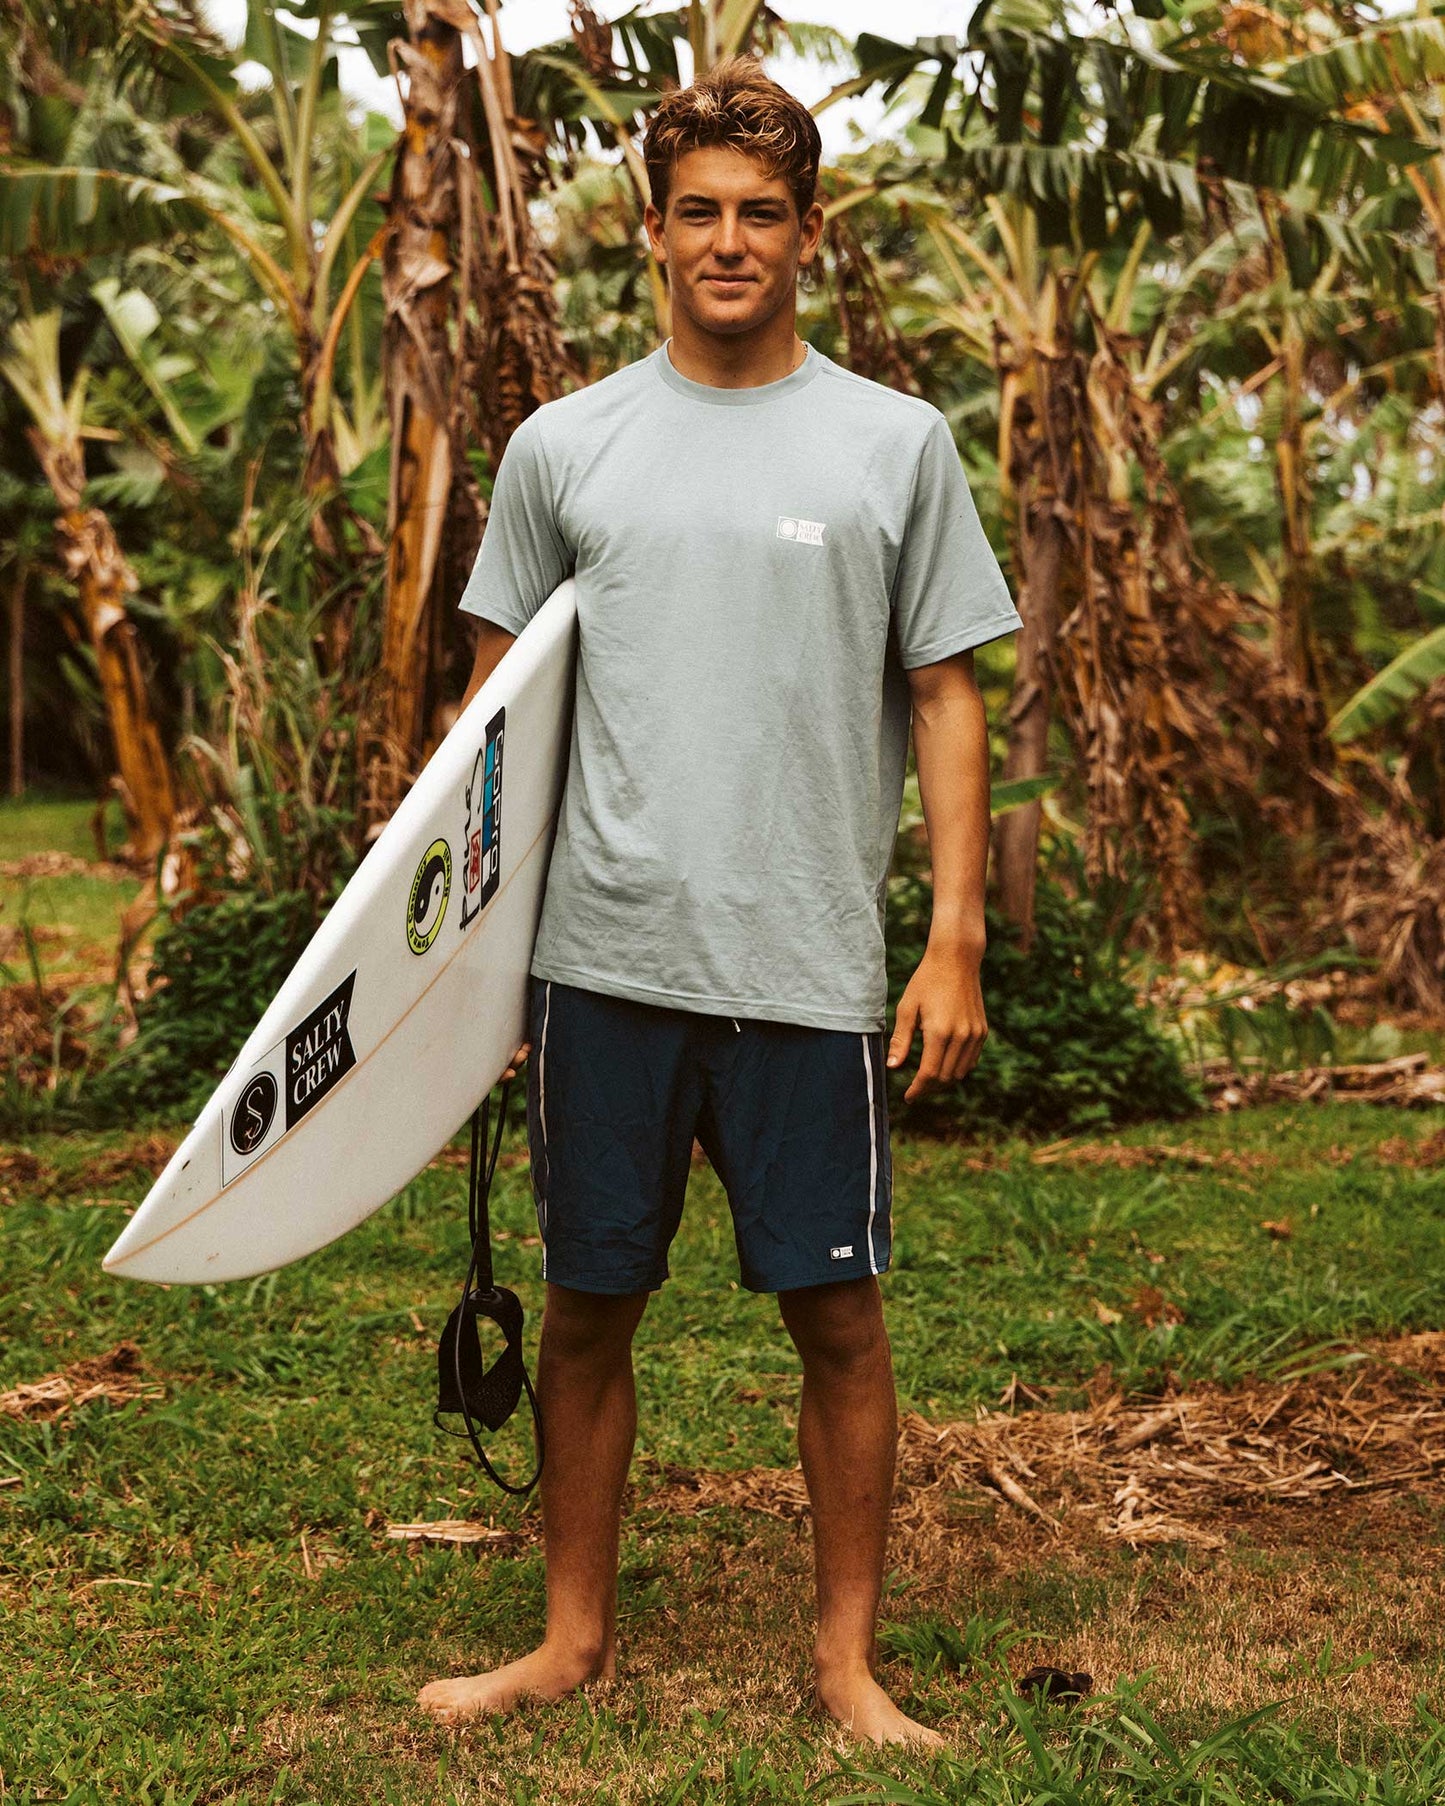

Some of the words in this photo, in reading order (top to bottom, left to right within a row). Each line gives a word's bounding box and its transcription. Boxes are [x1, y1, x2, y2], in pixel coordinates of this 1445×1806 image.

[490, 729, 504, 875] GoPro
[292, 1000, 346, 1075] SALTY
[293, 1037, 343, 1105] CREW
